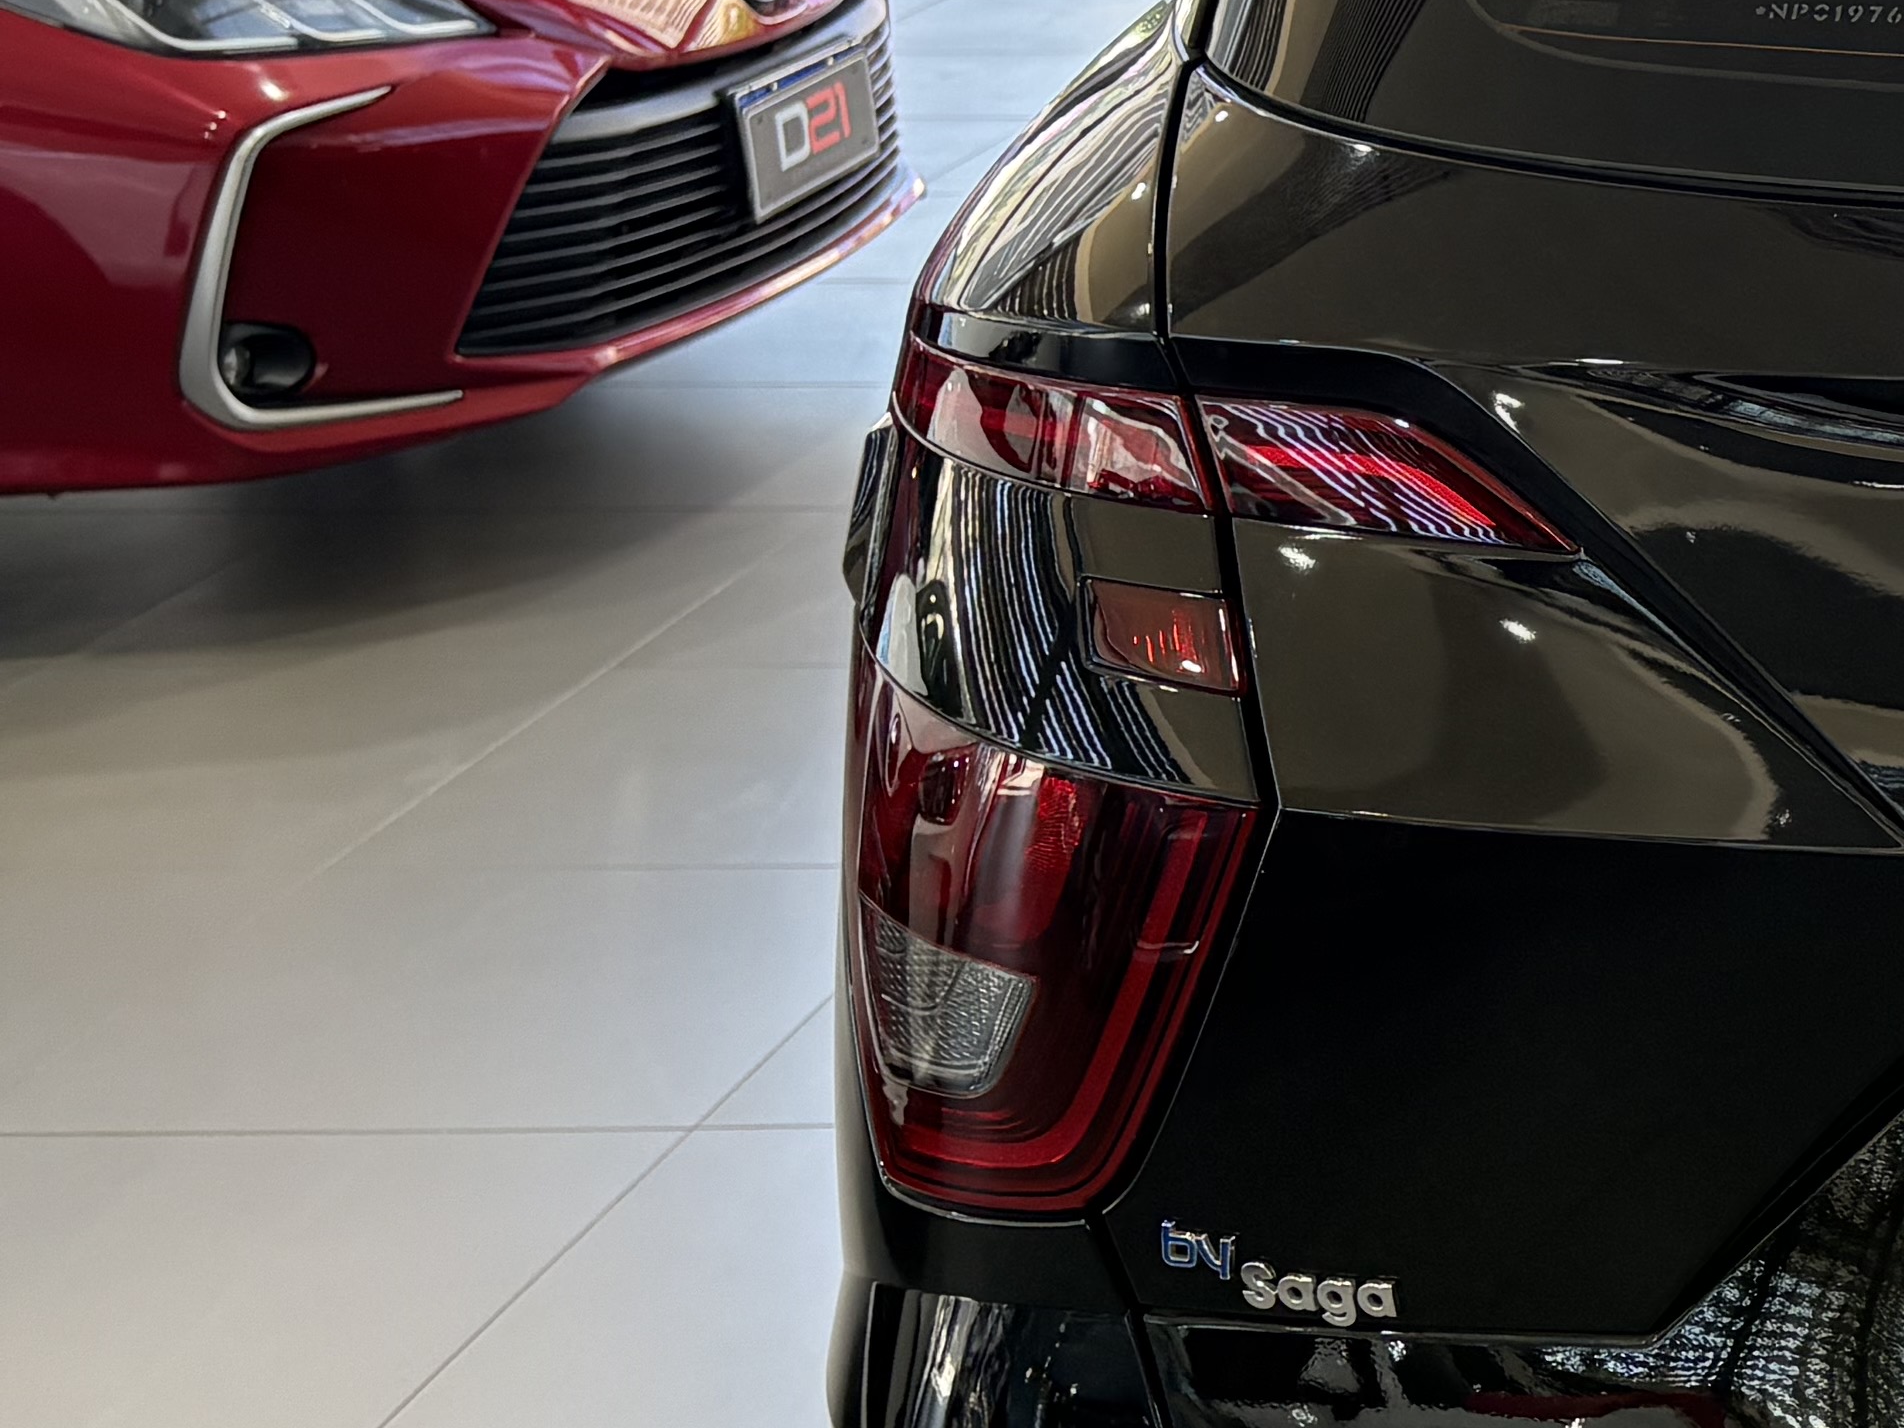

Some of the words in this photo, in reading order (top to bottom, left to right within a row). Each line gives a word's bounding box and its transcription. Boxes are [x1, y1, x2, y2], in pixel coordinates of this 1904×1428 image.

[774, 79, 852, 173] D21
[1160, 1220, 1237, 1280] by
[1240, 1260, 1400, 1327] Saga
